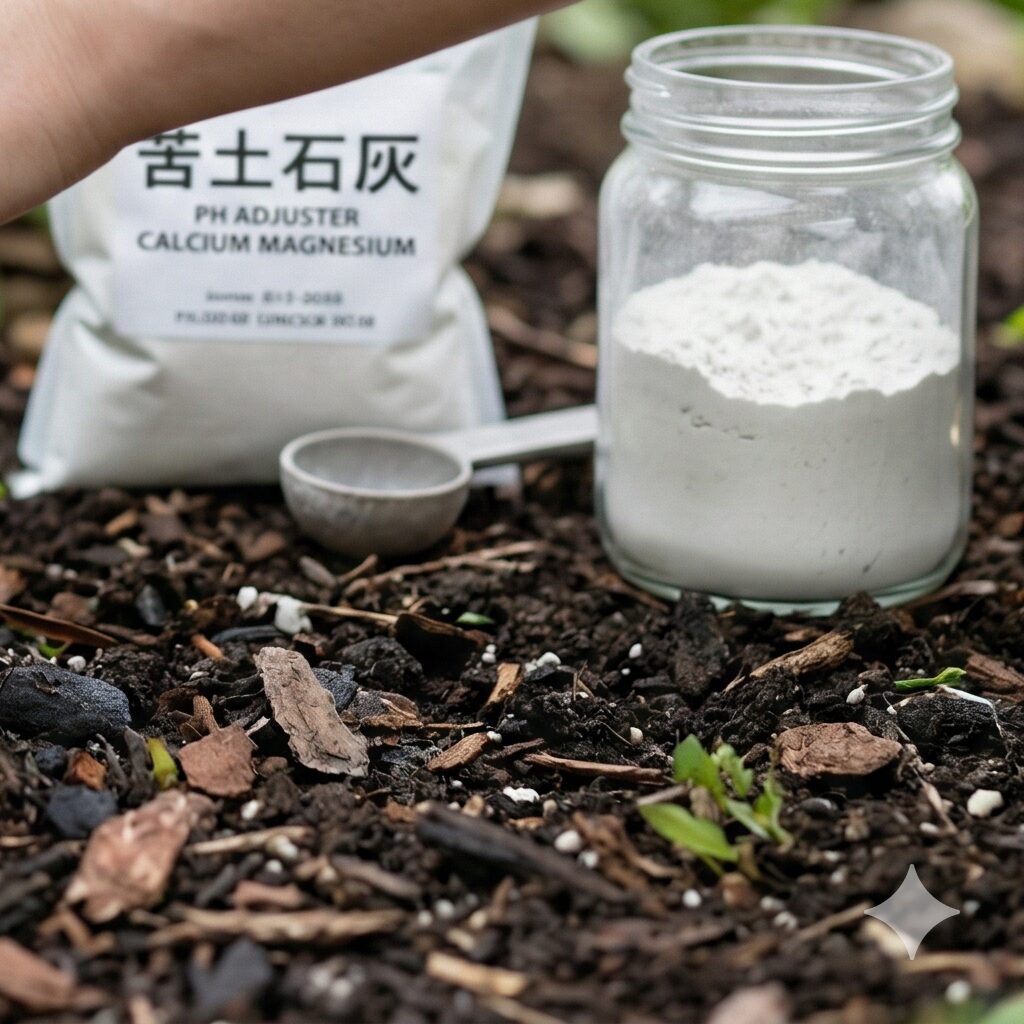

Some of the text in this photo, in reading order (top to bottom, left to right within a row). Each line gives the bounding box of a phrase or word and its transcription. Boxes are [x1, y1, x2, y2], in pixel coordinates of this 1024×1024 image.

[138, 129, 420, 194] 苦土石灰
[194, 205, 359, 227] PH ADJUSTER
[137, 230, 416, 257] CALCIUM MAGNESIUM
